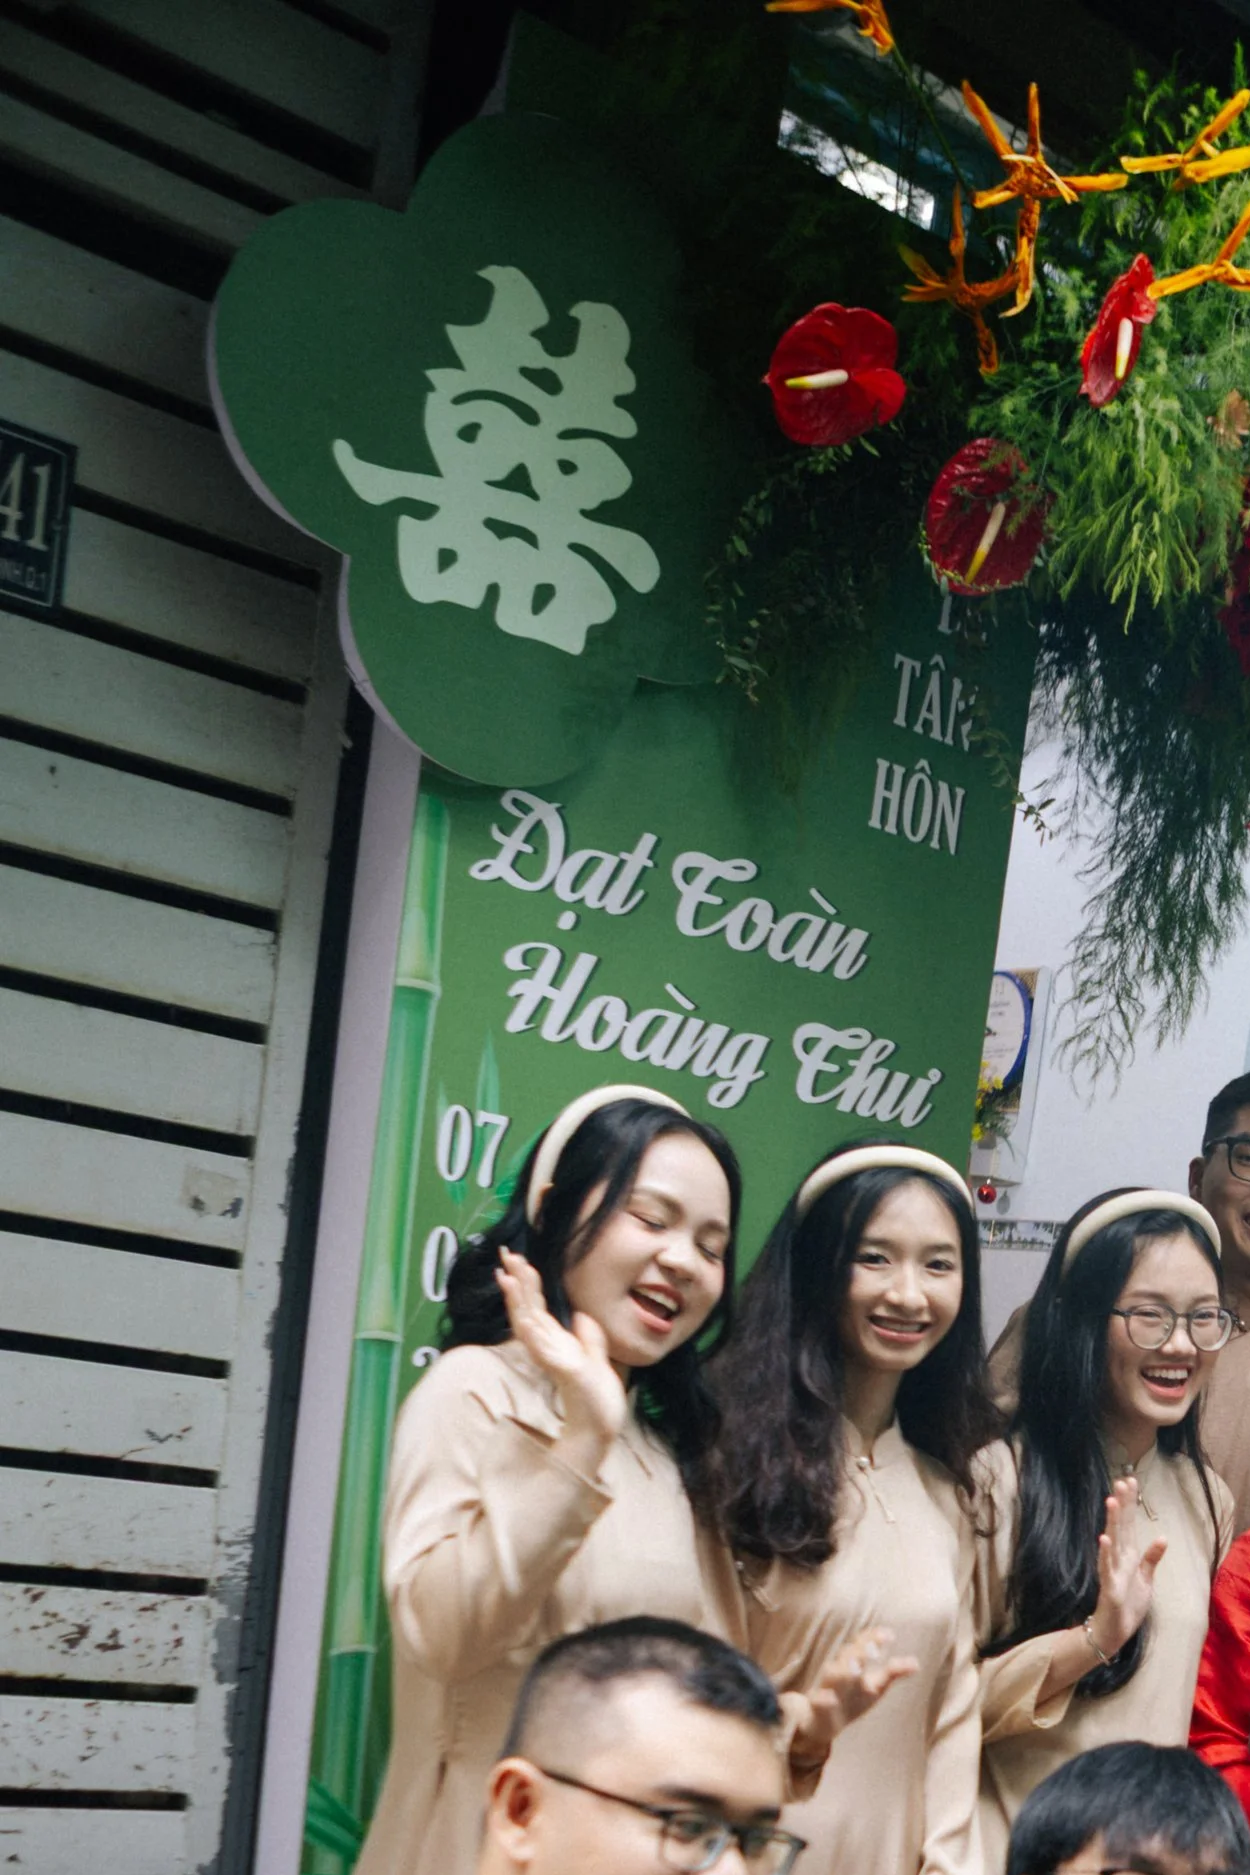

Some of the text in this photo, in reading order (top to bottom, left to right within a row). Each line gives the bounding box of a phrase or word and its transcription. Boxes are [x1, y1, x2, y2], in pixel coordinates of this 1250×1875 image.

[868, 758, 965, 856] HÔN
[468, 789, 870, 980] Đạt Toàn
[503, 942, 771, 1109] Hoàng
[436, 1104, 510, 1188] 07
[421, 1226, 485, 1302] 0
